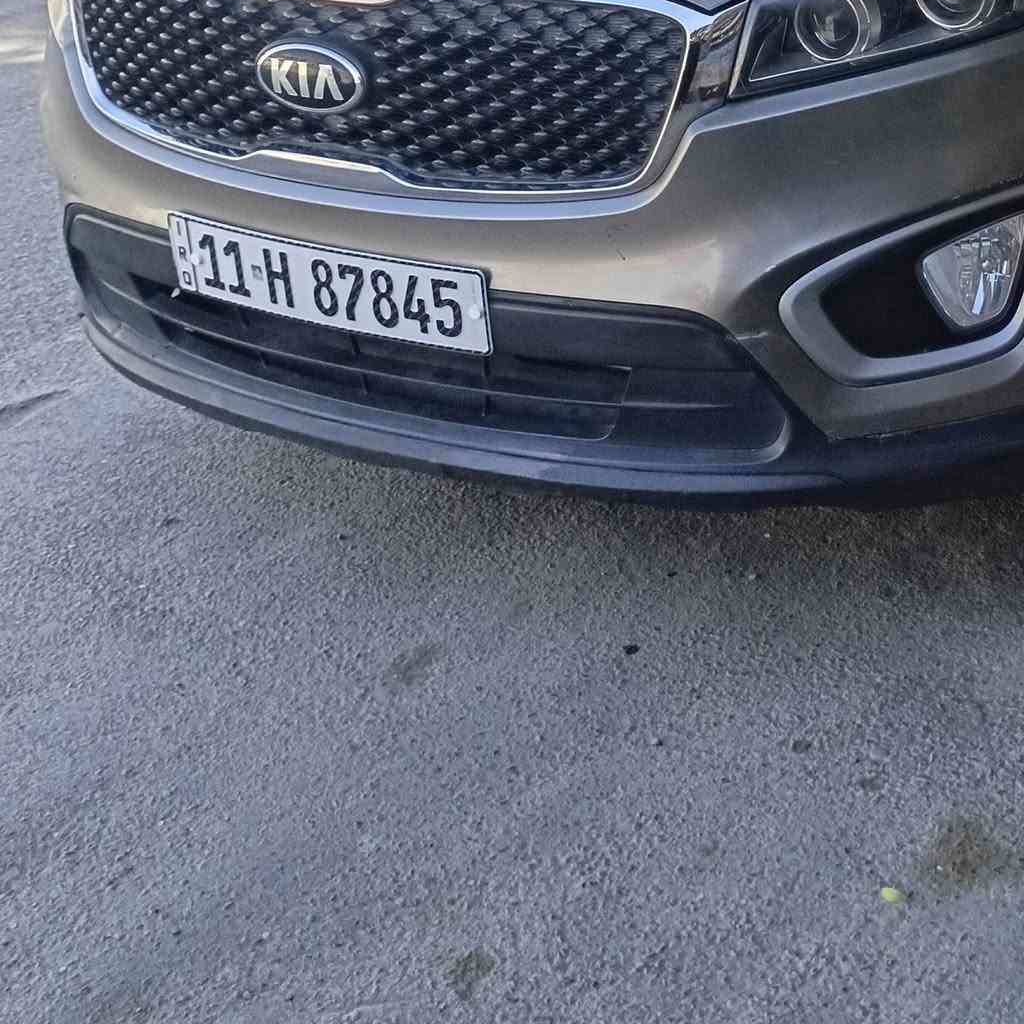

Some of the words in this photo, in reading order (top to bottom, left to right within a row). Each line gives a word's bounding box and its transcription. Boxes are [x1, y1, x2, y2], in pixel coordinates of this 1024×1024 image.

[269, 58, 344, 100] KIA
[199, 234, 251, 297] 11
[262, 248, 295, 308] H
[311, 259, 463, 337] 87845
